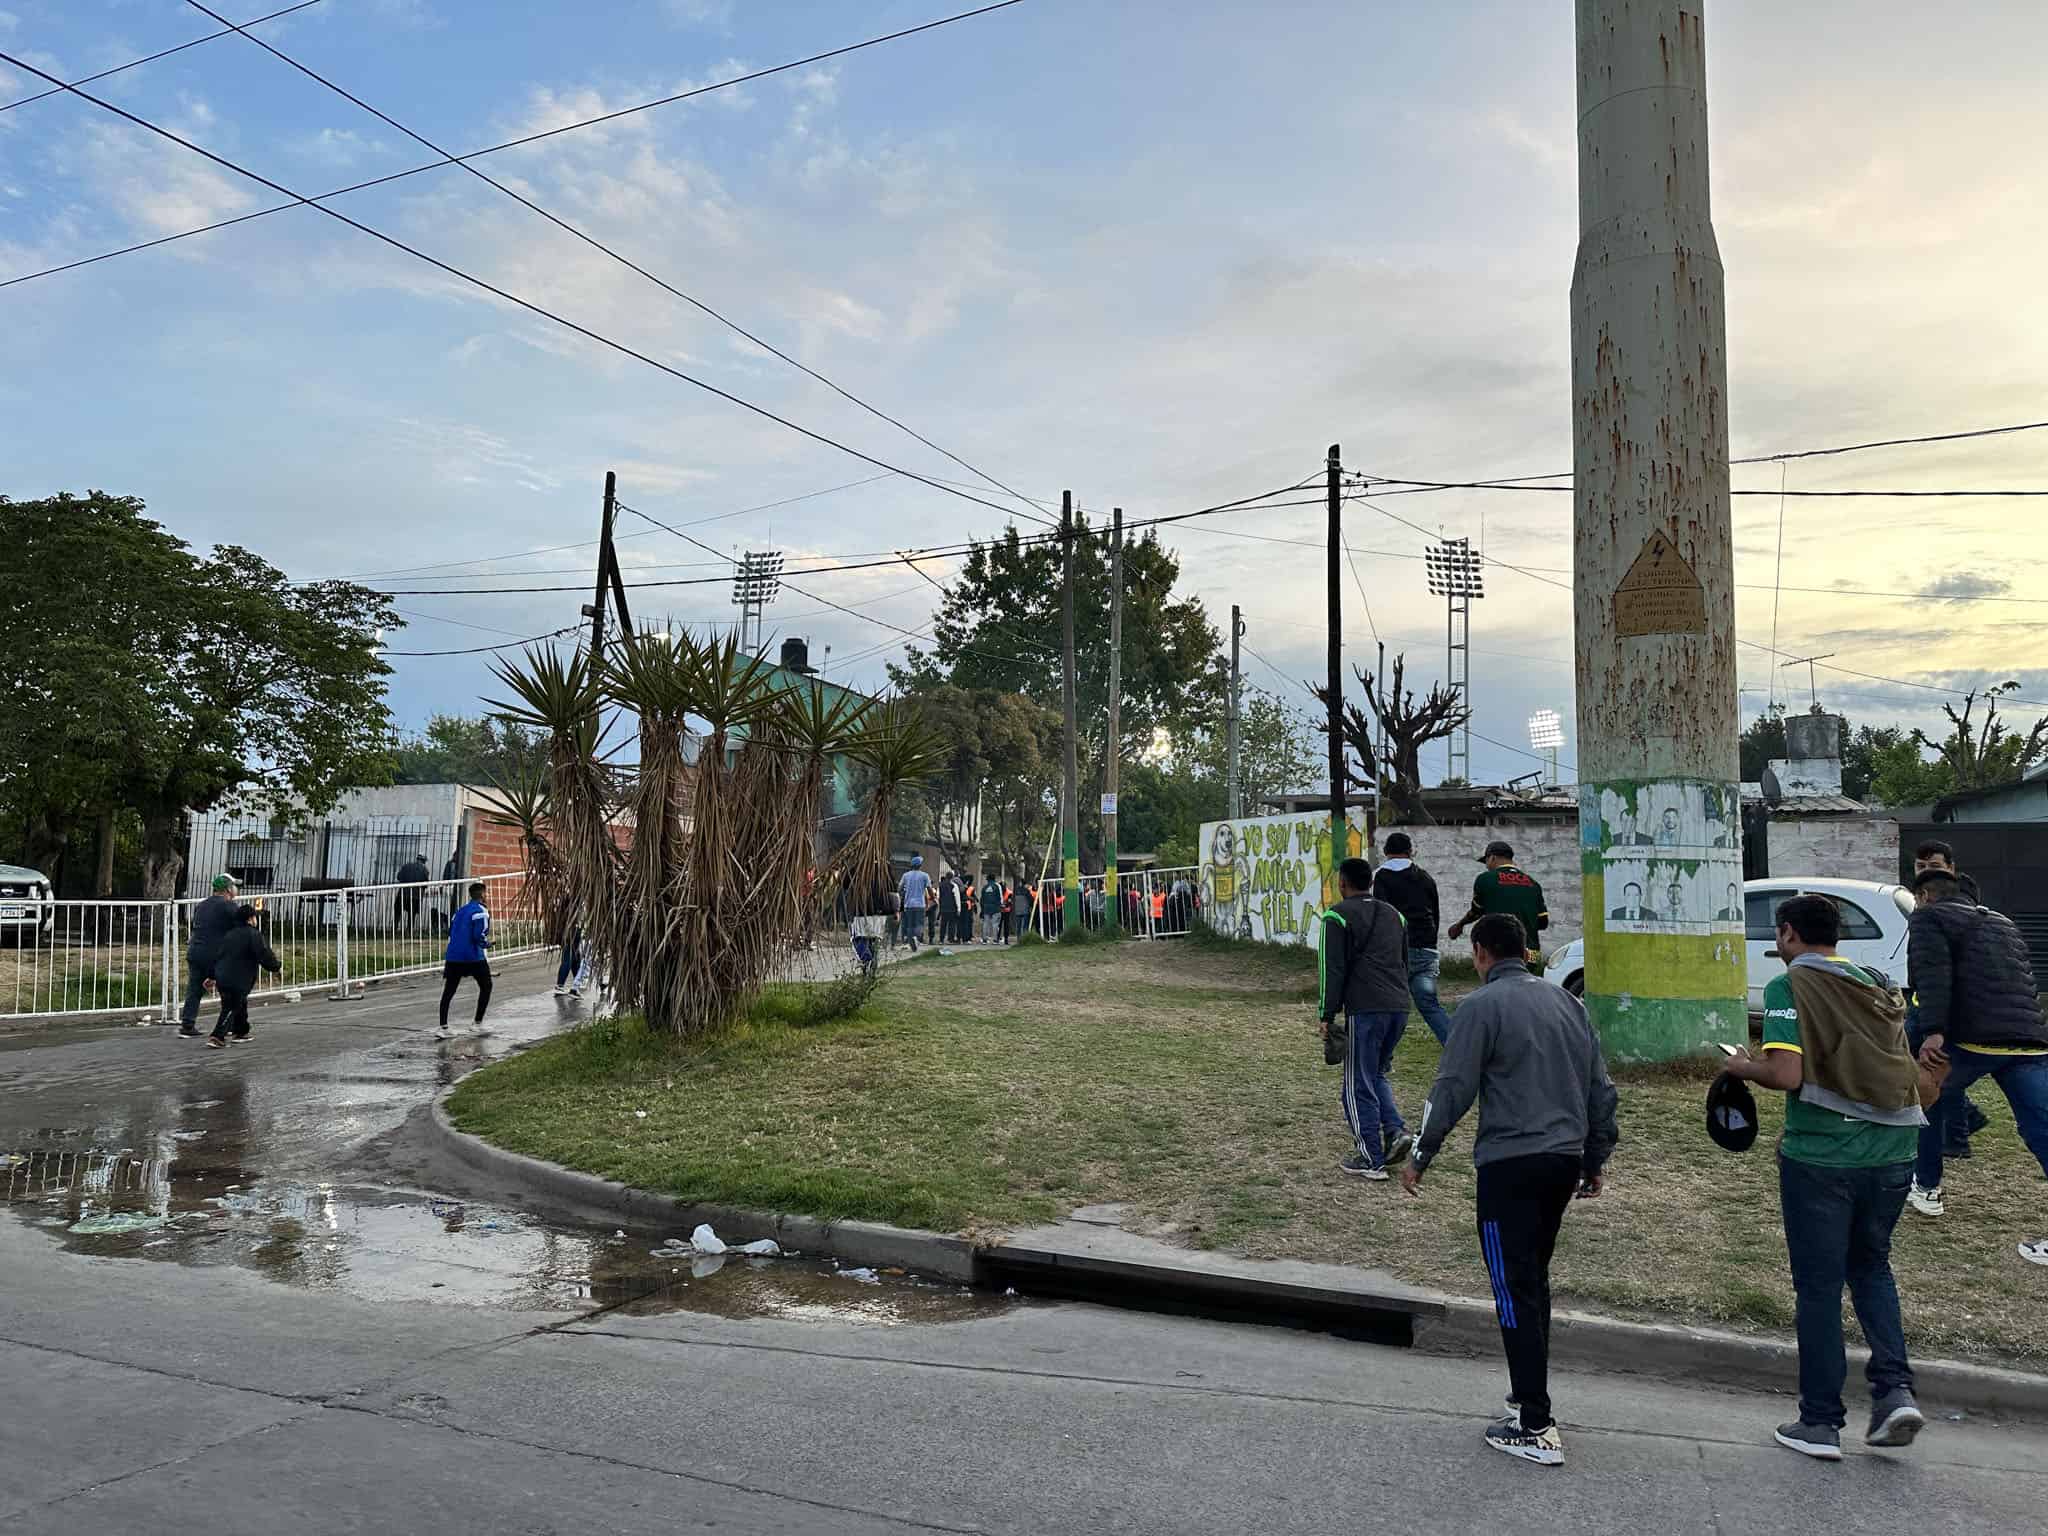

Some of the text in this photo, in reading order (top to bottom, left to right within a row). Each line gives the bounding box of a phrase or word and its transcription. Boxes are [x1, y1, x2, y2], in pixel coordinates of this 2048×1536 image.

[1242, 821, 1313, 857] YO SOY TU
[1251, 857, 1306, 896] AMIGO
